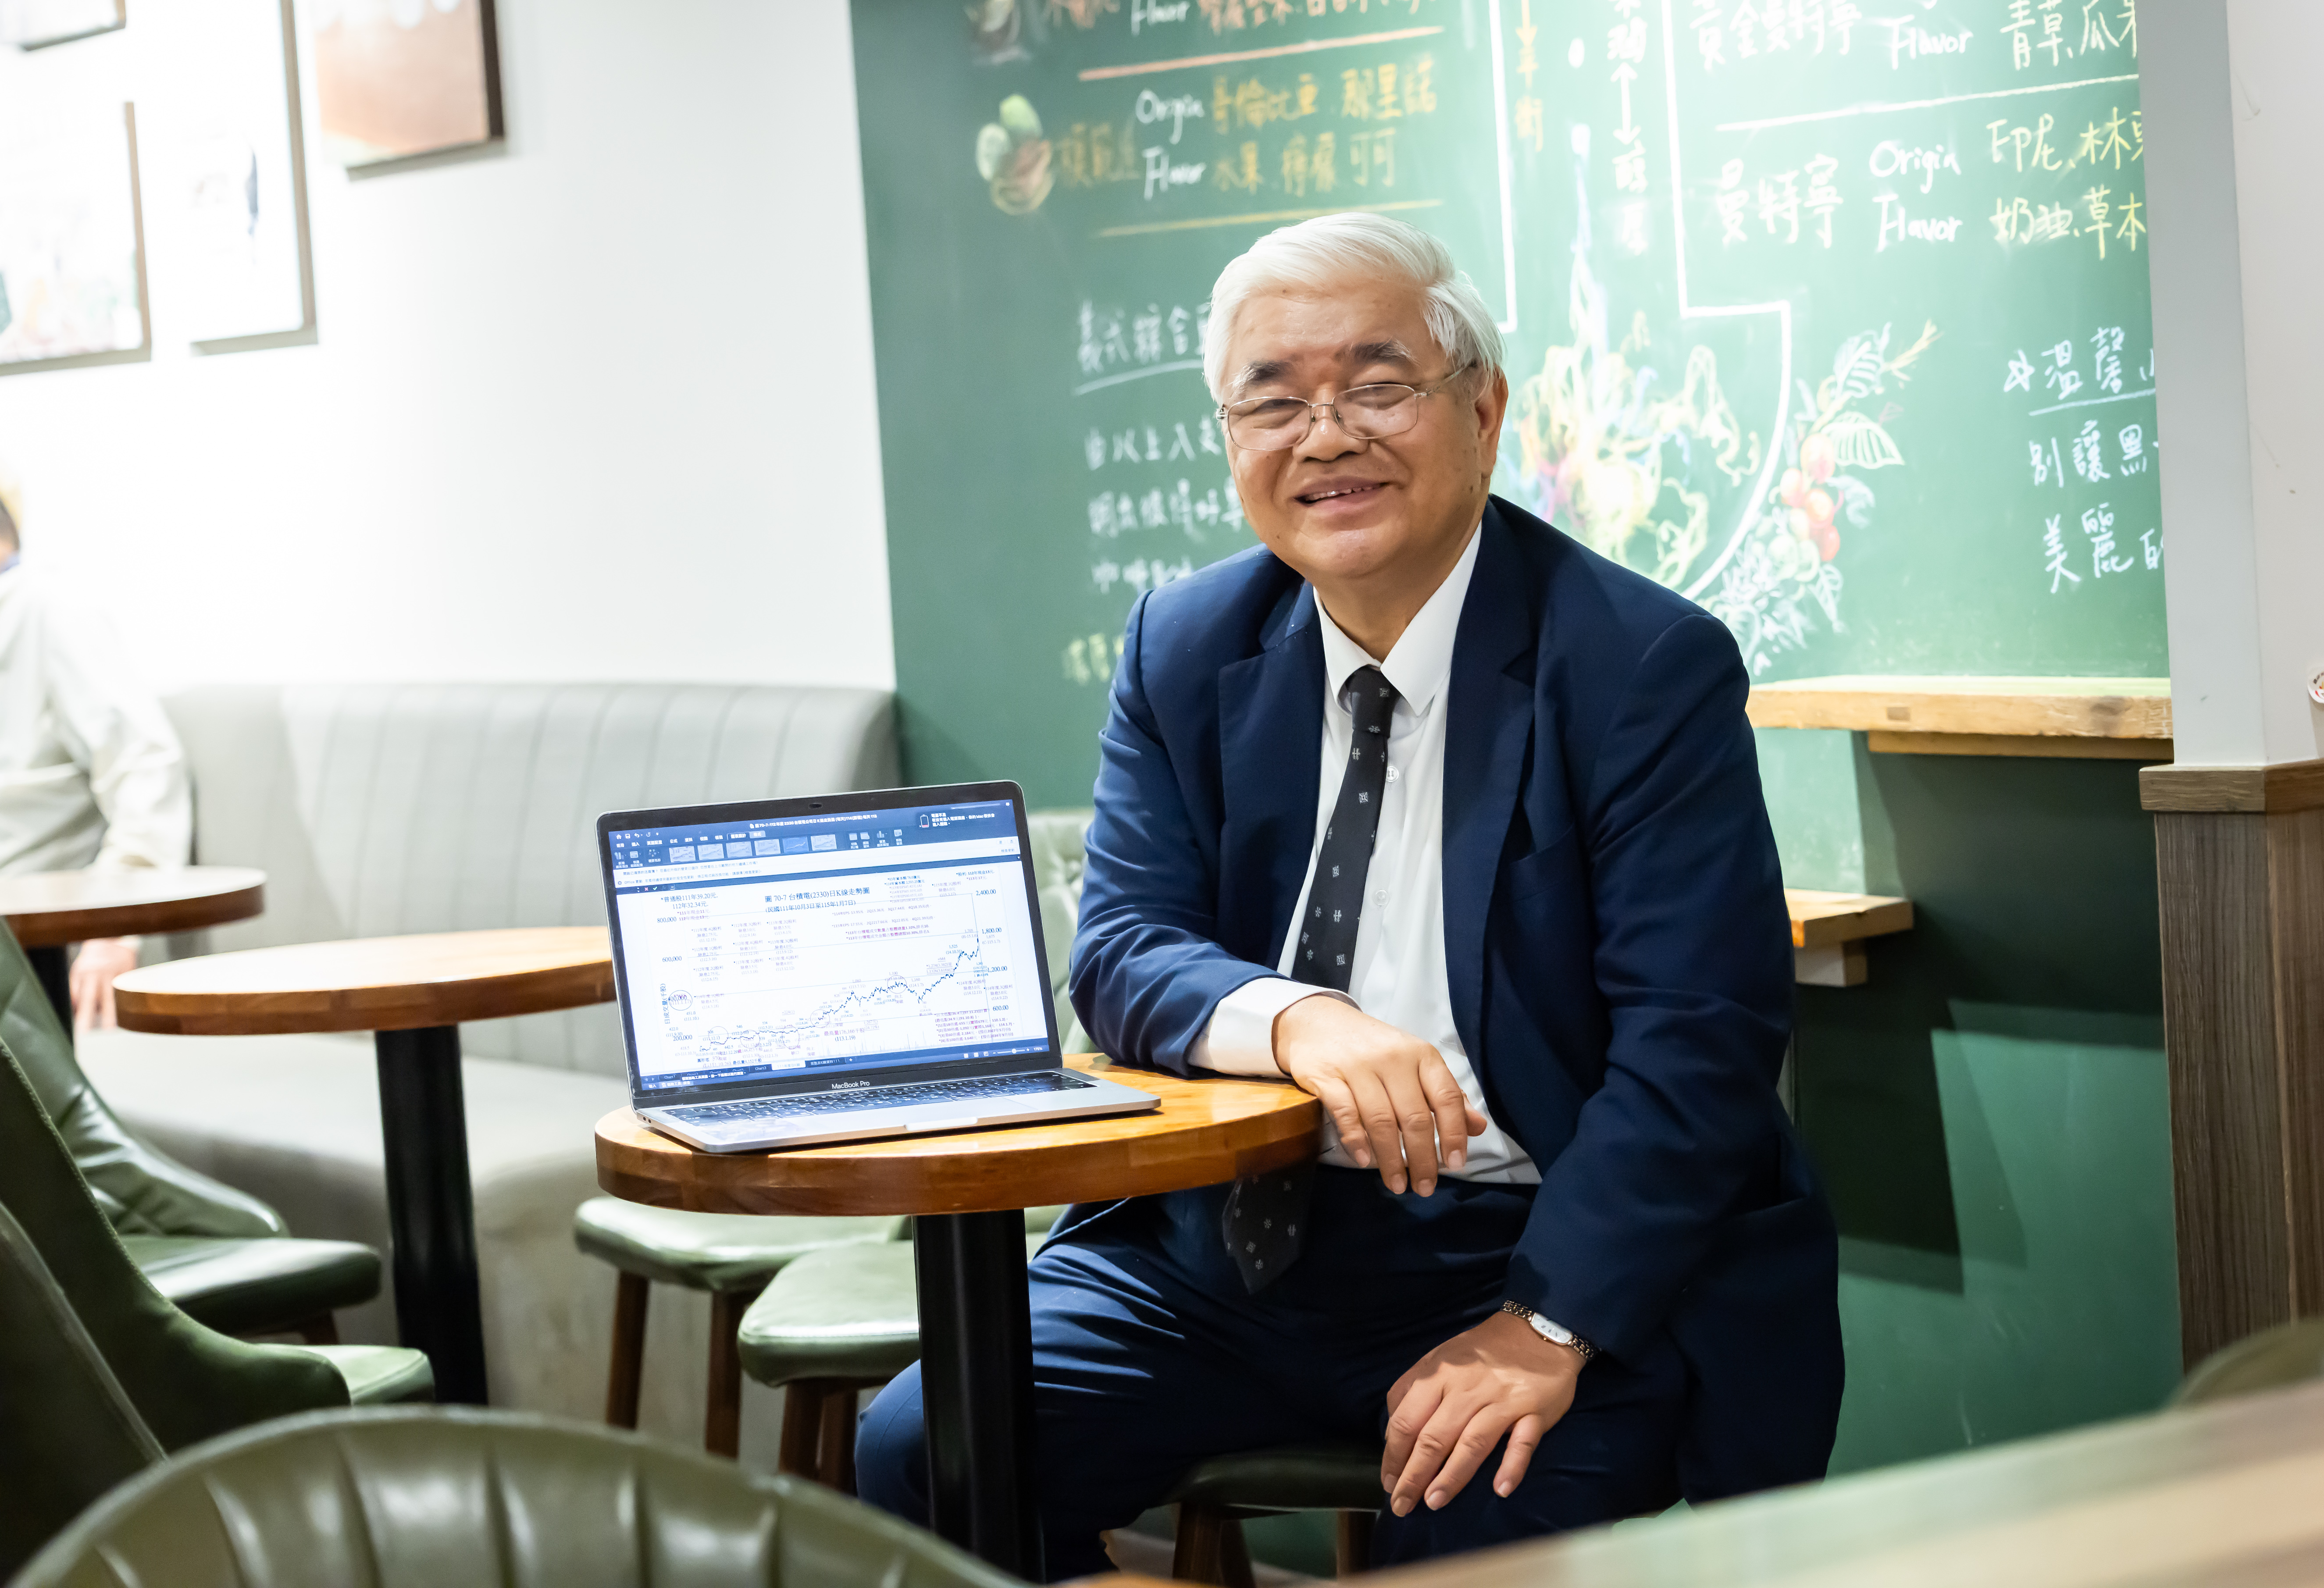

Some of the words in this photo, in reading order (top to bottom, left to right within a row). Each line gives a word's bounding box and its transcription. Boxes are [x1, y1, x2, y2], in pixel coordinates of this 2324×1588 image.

[1869, 140, 1961, 193] Origin
[1872, 193, 1964, 253] Flavor
[765, 899, 856, 914] (民國111年10月3日至115年1月7日)
[788, 886, 870, 901] 台積電(2330)日K線走勢圖
